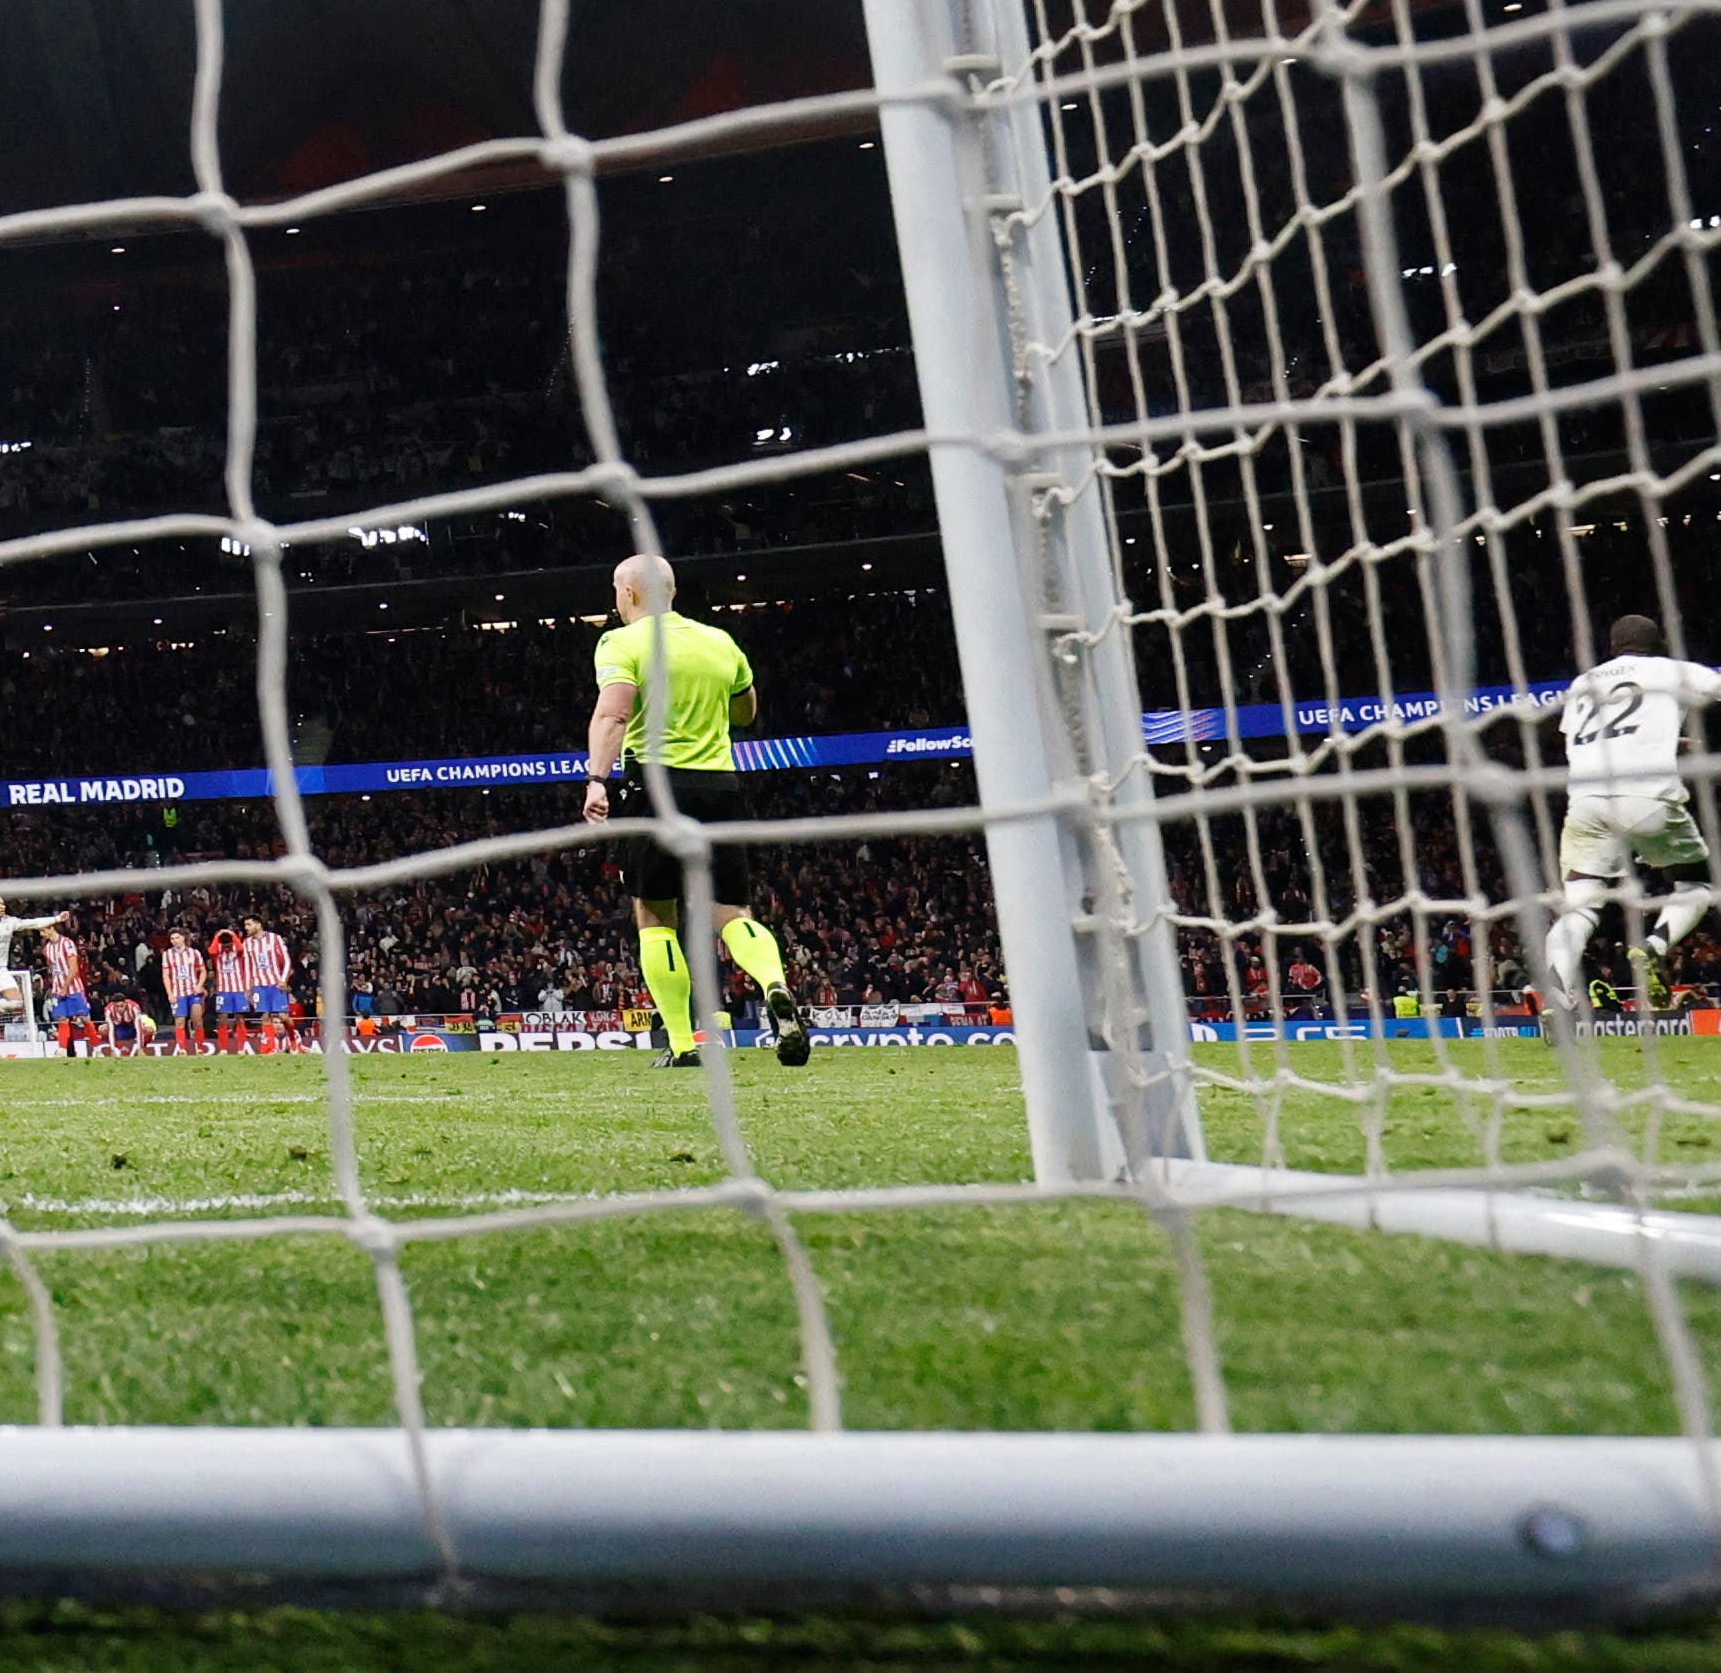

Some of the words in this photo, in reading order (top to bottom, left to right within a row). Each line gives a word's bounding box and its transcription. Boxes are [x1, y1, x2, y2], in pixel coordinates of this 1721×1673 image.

[1299, 707, 1355, 726] UEFA
[1359, 694, 1496, 722] CHAMPNS
[1573, 681, 1644, 746] 22
[386, 767, 433, 783] UEFA
[436, 762, 547, 781] CHAMPIONS
[549, 757, 622, 775] LEAE
[8, 783, 76, 805] REAL
[80, 777, 186, 802] MADRID
[526, 1012, 583, 1025] OBLAK
[1575, 1012, 1691, 1037] masterard
[479, 1030, 653, 1051] PEPSI
